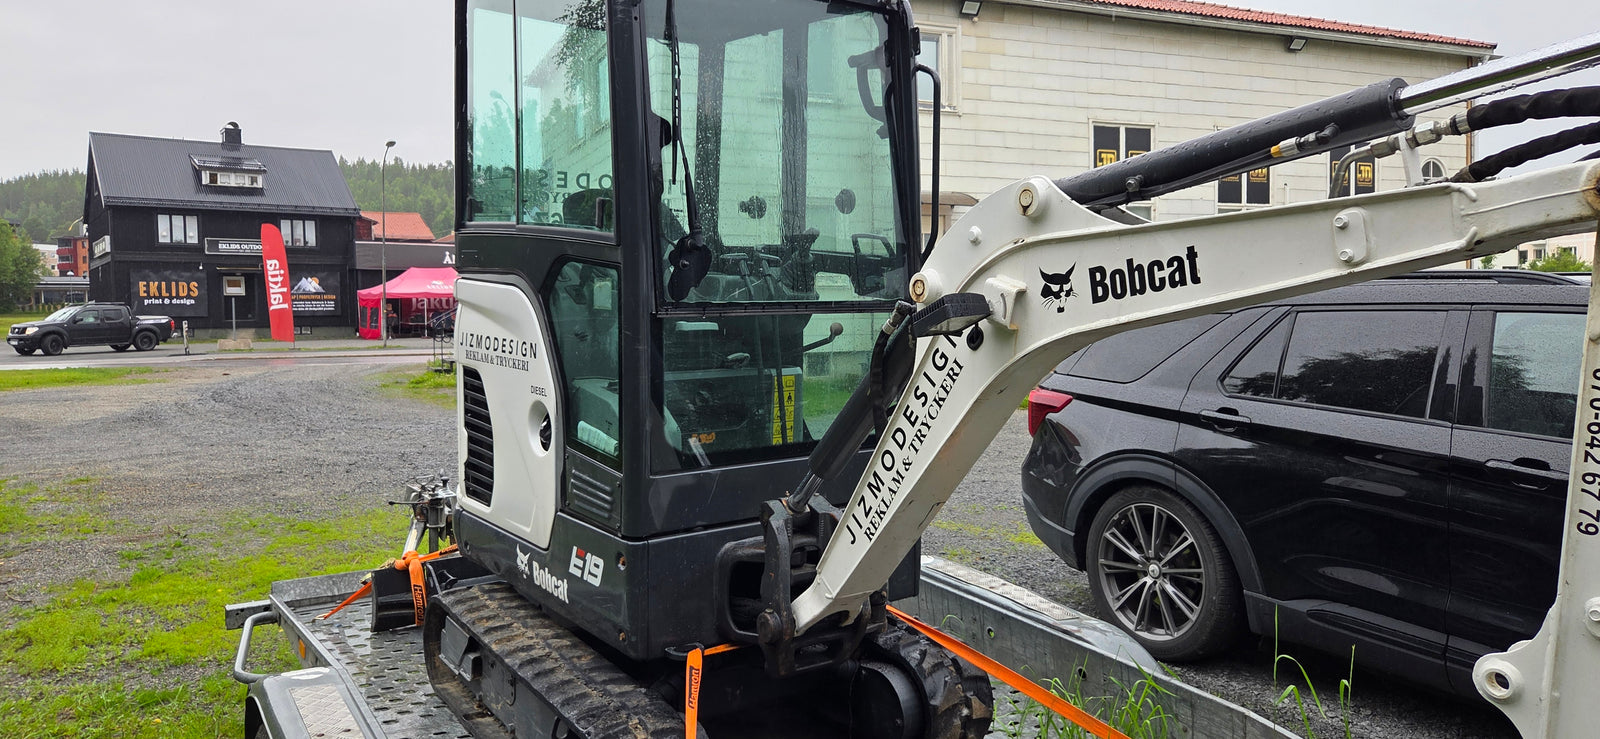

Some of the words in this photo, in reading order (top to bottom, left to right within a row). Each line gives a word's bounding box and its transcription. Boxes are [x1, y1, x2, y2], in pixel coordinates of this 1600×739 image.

[139, 281, 199, 297] EKLIDS
[1089, 245, 1202, 305] Bobcat
[172, 298, 195, 306] design
[459, 332, 537, 359] JIZMODESIGN
[465, 350, 490, 365] REKLAM
[490, 356, 495, 365] &
[495, 357, 530, 372] TRYCKERI
[530, 385, 548, 398] DIESEL
[908, 358, 965, 456] TRYCKERI
[903, 455, 914, 471] &
[863, 471, 906, 542] REKLAM
[1576, 508, 1600, 536] 79
[569, 545, 604, 587] E19
[533, 560, 570, 604] Bobcat
[413, 585, 424, 620] Hamron
[688, 668, 700, 709] Hamron
